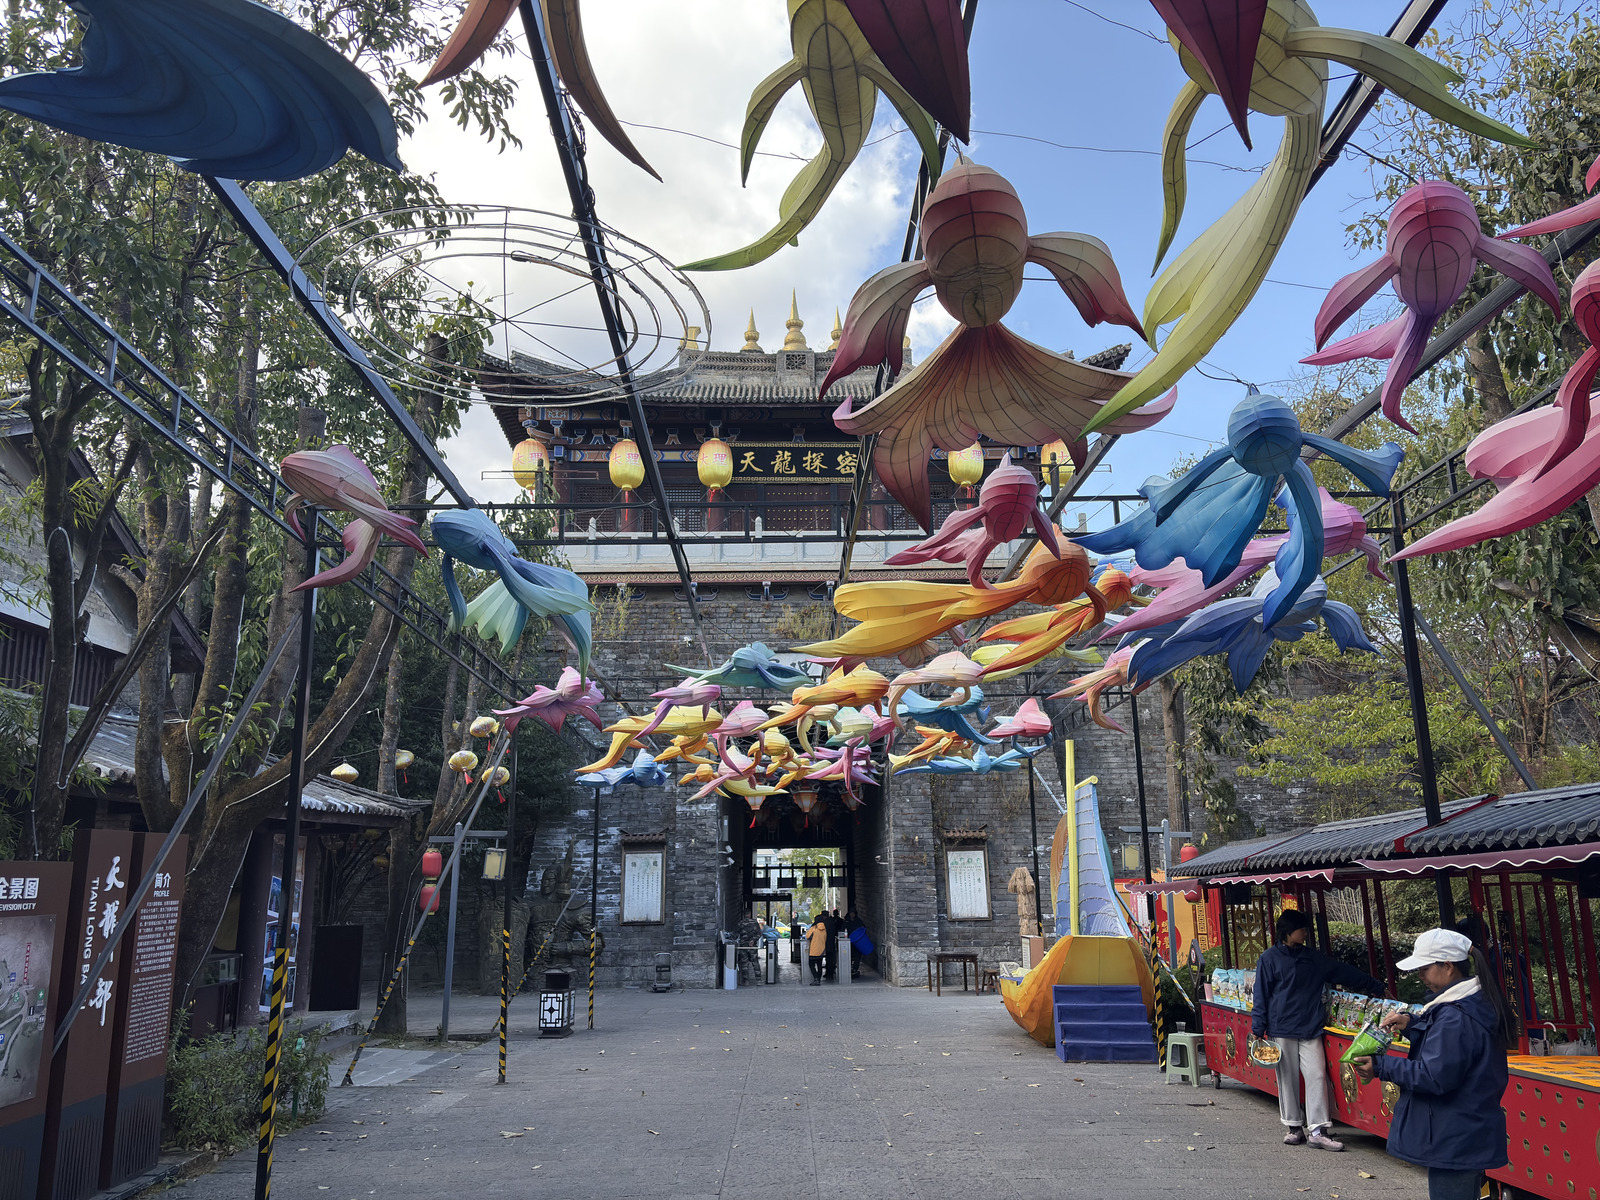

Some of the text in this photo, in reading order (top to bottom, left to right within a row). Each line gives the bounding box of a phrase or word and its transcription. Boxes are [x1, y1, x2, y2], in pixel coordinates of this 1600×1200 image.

[612, 452, 640, 467] 大理
[700, 452, 728, 467] 大理
[738, 450, 858, 475] 天龍探密
[0, 876, 40, 900] 全景图
[154, 872, 172, 888] 简介
[88, 877, 100, 913] TIAN
[153, 890, 170, 898] PROFILE
[22, 902, 37, 910] CITY
[82, 916, 96, 960] LONG
